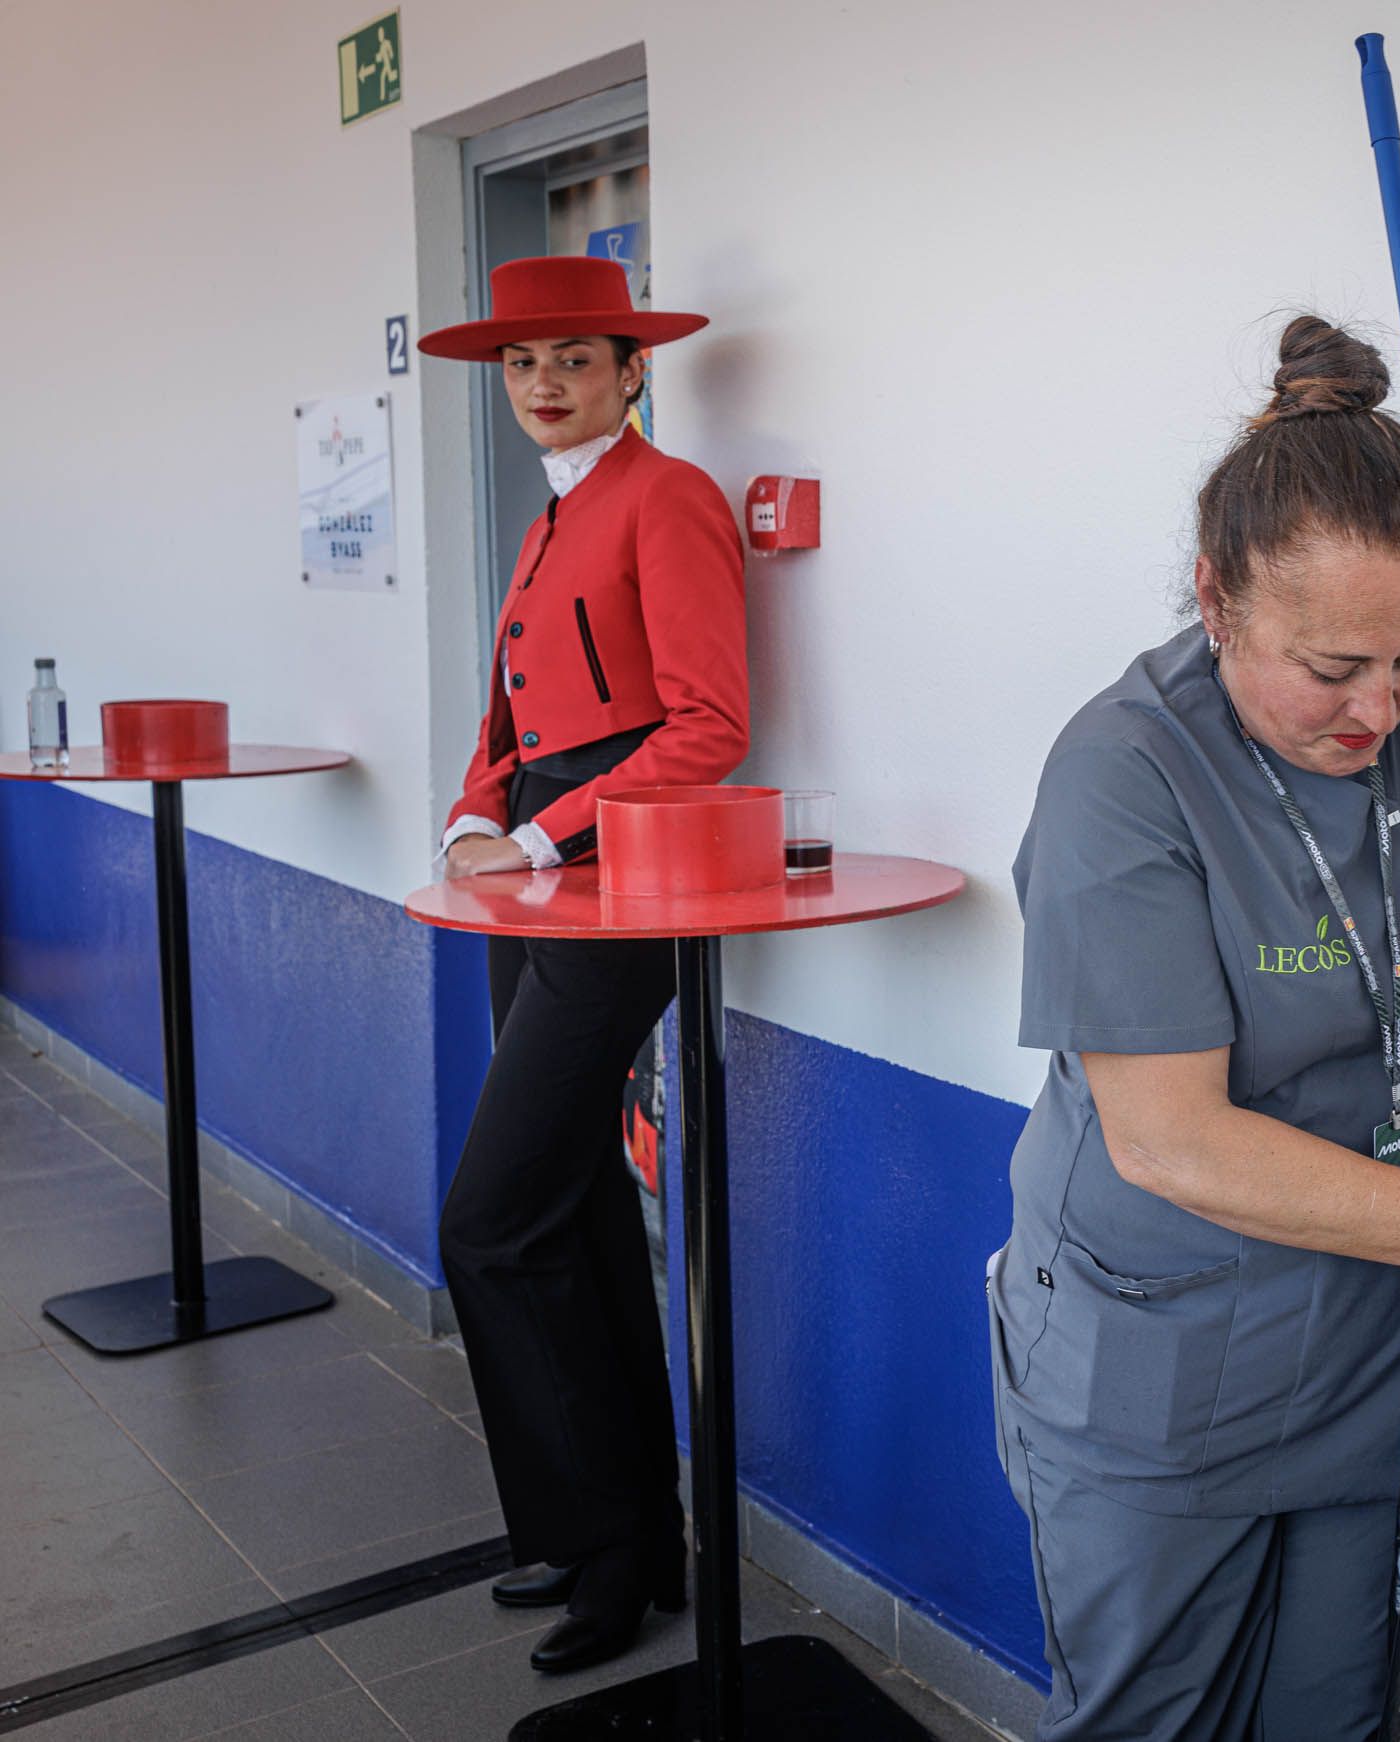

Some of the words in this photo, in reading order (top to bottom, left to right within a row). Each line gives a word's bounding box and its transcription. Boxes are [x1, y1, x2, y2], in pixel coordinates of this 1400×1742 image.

[390, 322, 406, 369] 2
[330, 540, 362, 559] BYASS
[1247, 739, 1265, 763] SPAIN
[1301, 830, 1333, 880] MotoGP
[1255, 938, 1352, 974] LECOS
[1350, 929, 1366, 956] SPAIN
[1392, 936, 1400, 963] SPAIN
